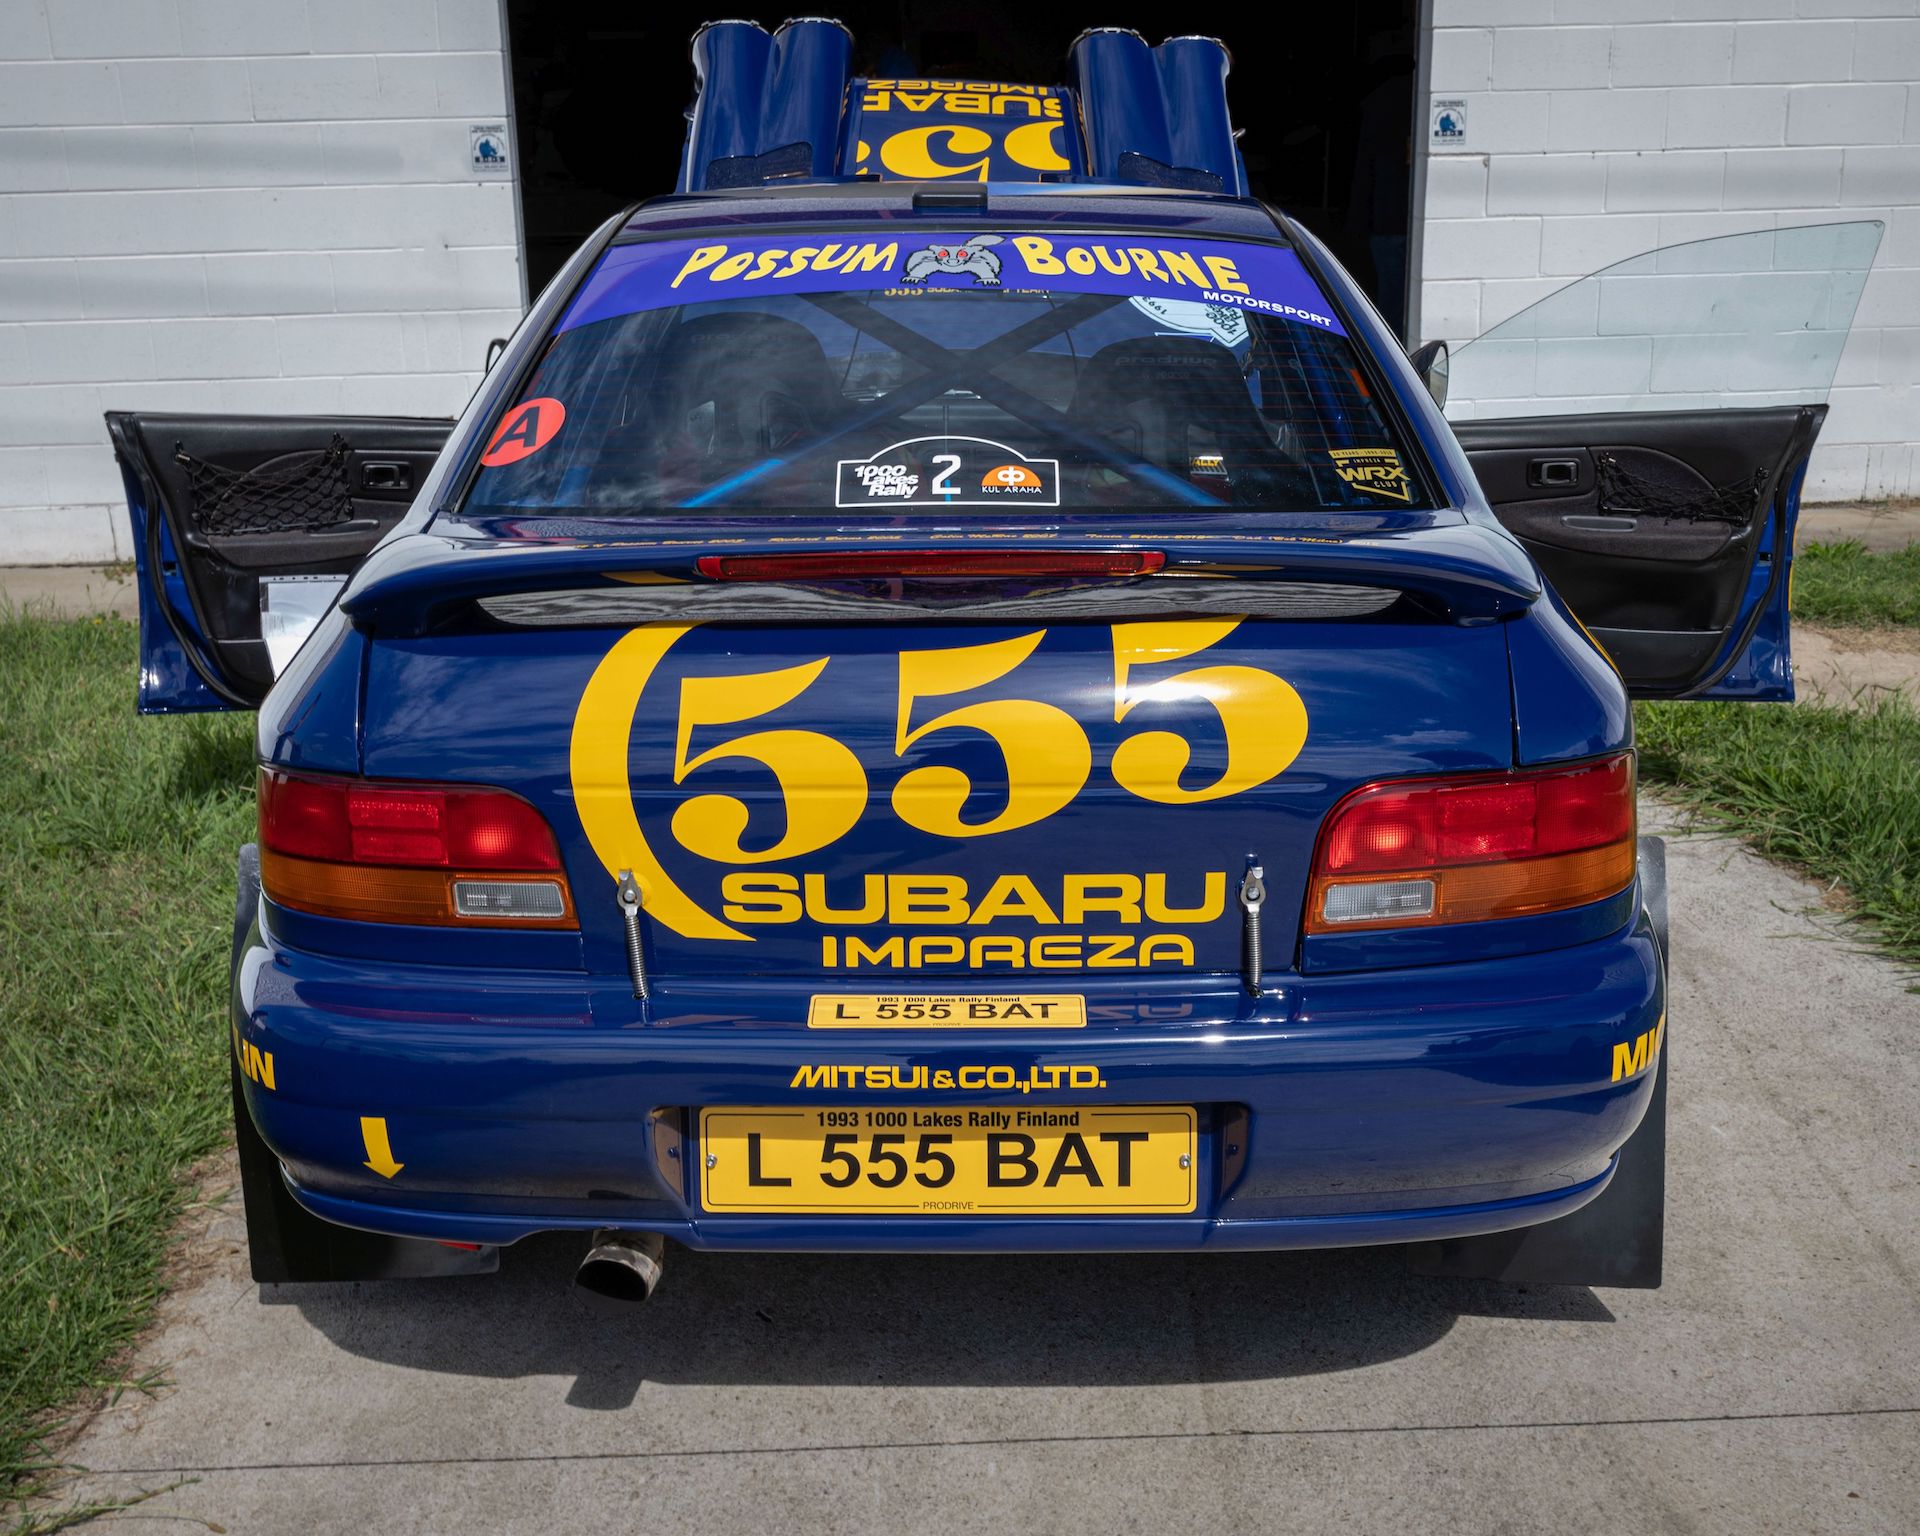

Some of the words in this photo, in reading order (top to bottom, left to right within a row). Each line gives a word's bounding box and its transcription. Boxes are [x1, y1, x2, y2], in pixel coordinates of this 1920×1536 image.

[1202, 290, 1332, 327] MOTORSPORT
[486, 405, 540, 456] A
[854, 464, 907, 478] 1000
[931, 454, 962, 495] 2
[1335, 466, 1411, 481] WRX
[862, 475, 919, 486] Lakes
[1373, 480, 1398, 488] CLUB
[868, 484, 919, 499] Rally
[721, 871, 1227, 925] SUBARU
[822, 935, 1195, 968] IMPREZA
[959, 996, 983, 1004] Rally
[835, 1003, 860, 1019] L
[875, 1003, 952, 1020] 555
[968, 1003, 1059, 1019] BAT
[816, 1111, 859, 1127] 1993
[865, 1111, 907, 1127] 1000
[913, 1111, 963, 1127] Lakes
[968, 1111, 1011, 1130] Rally
[1016, 1111, 1080, 1127] Finland
[747, 1132, 792, 1187] L
[819, 1133, 956, 1188] 555
[986, 1132, 1149, 1187] BAT
[922, 1201, 974, 1210] PRODRIVE
